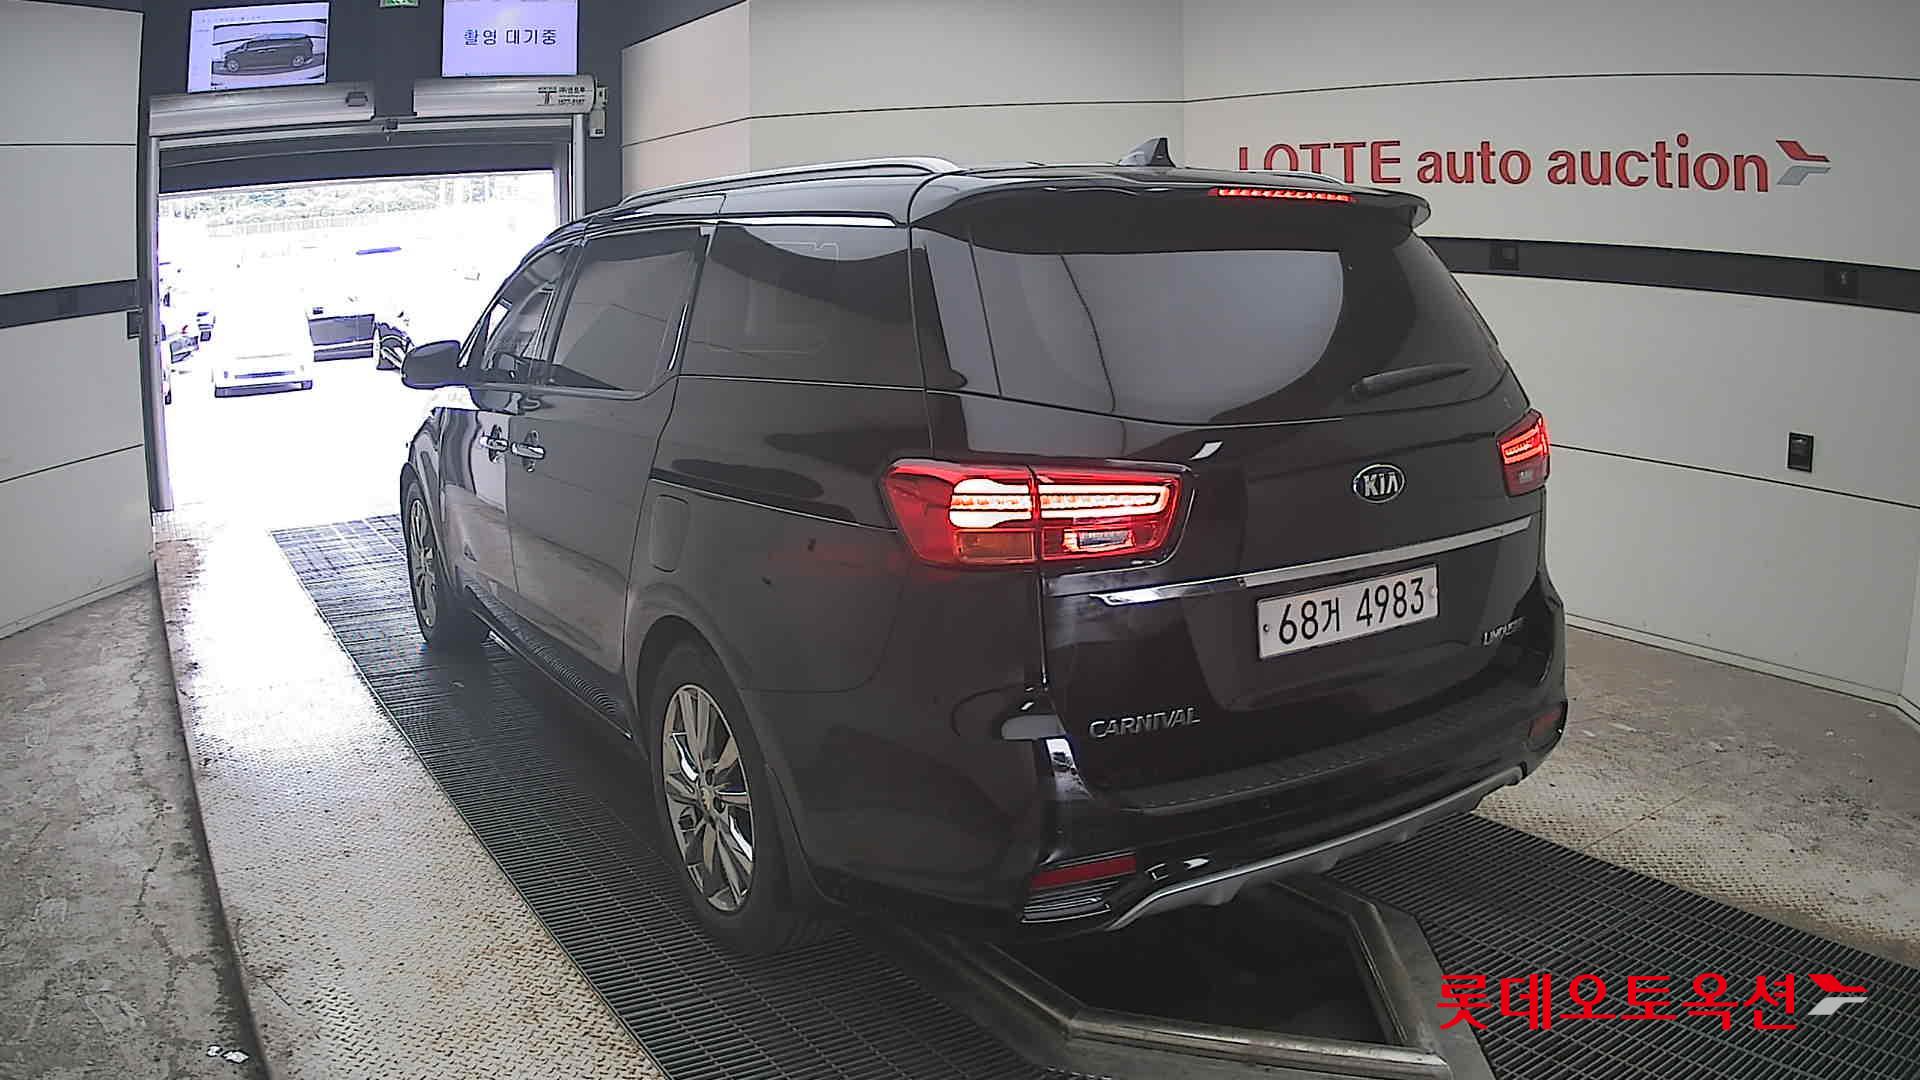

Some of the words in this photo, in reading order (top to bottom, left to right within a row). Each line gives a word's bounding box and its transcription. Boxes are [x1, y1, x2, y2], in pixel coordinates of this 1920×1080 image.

[505, 29, 557, 46] 대기중
[1416, 140, 1532, 185] auto
[1546, 133, 1769, 192] auction
[1363, 471, 1398, 497] KIA
[1278, 597, 1341, 645] 68거
[1356, 576, 1424, 627] 4983
[1089, 706, 1201, 739] CARNIVAL
